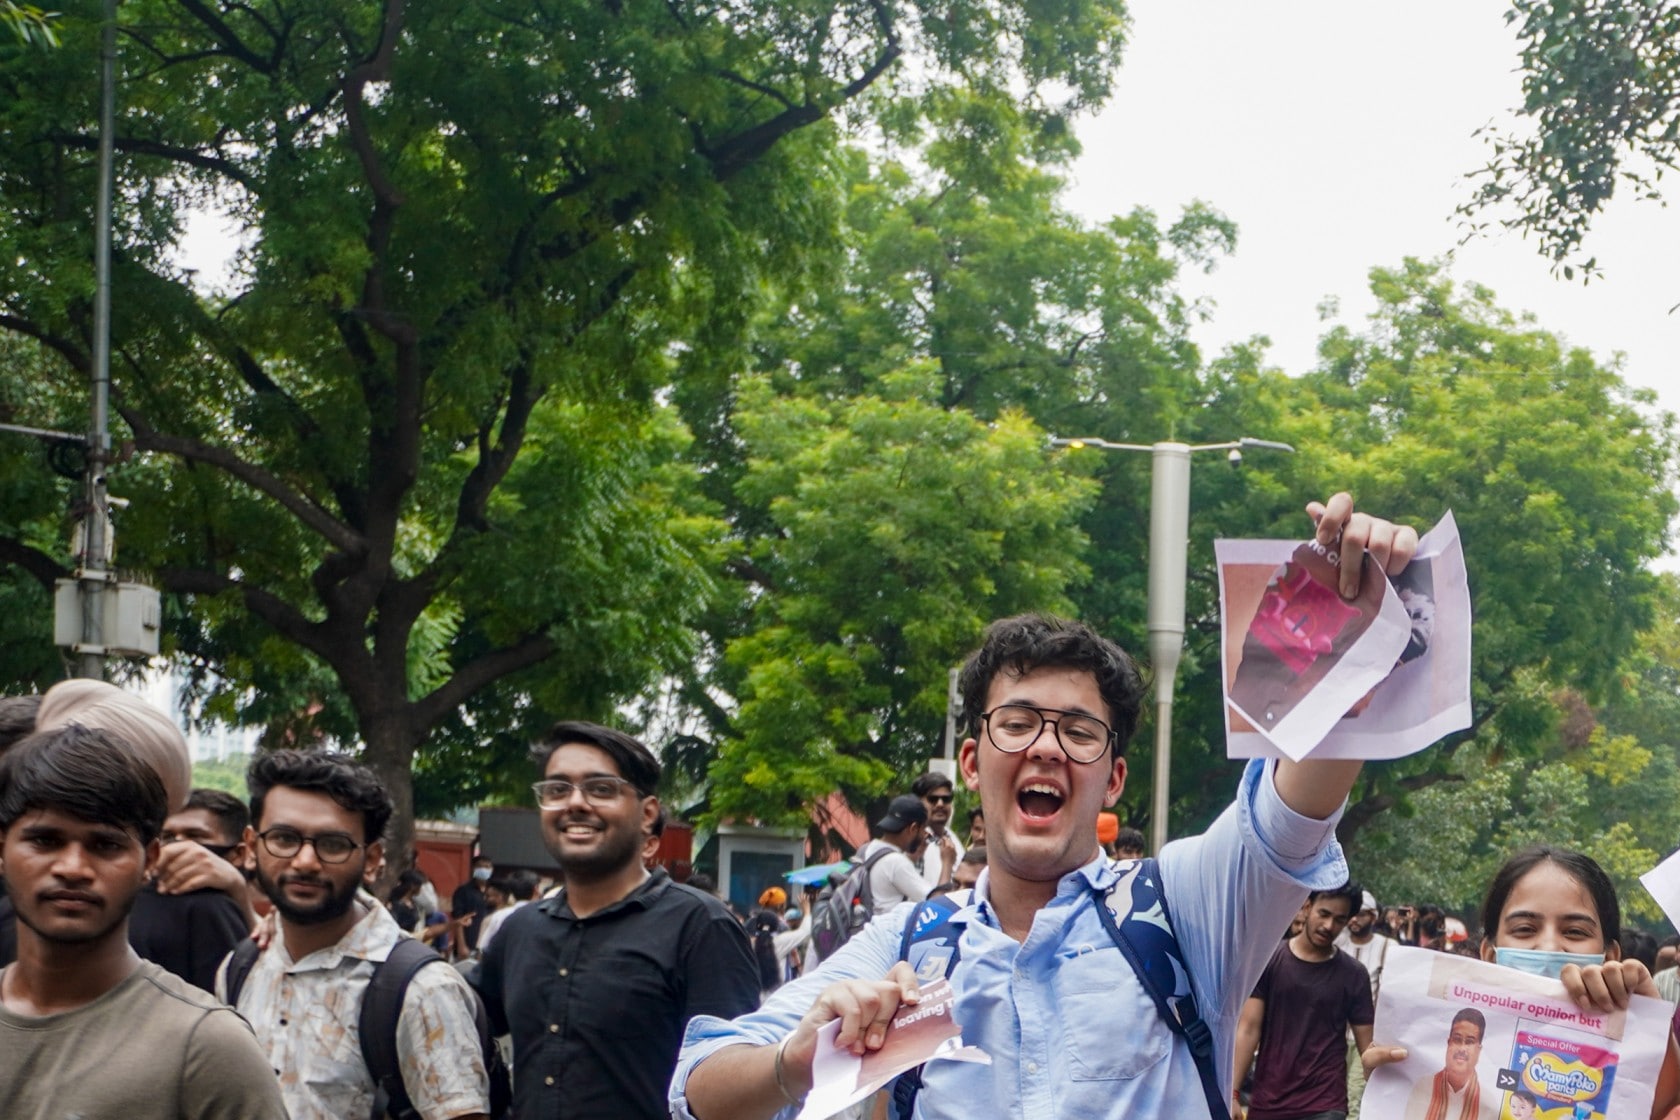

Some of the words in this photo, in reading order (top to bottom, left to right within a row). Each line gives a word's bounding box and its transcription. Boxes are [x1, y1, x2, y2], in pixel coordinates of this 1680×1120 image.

[893, 1003, 945, 1029] leaving
[1454, 985, 1525, 1011] Unpopular
[1527, 1003, 1576, 1022] opinion
[1578, 1014, 1603, 1029] but
[1527, 1035, 1558, 1049] Special
[1559, 1040, 1581, 1053] Offer
[1548, 1082, 1577, 1096] pants
